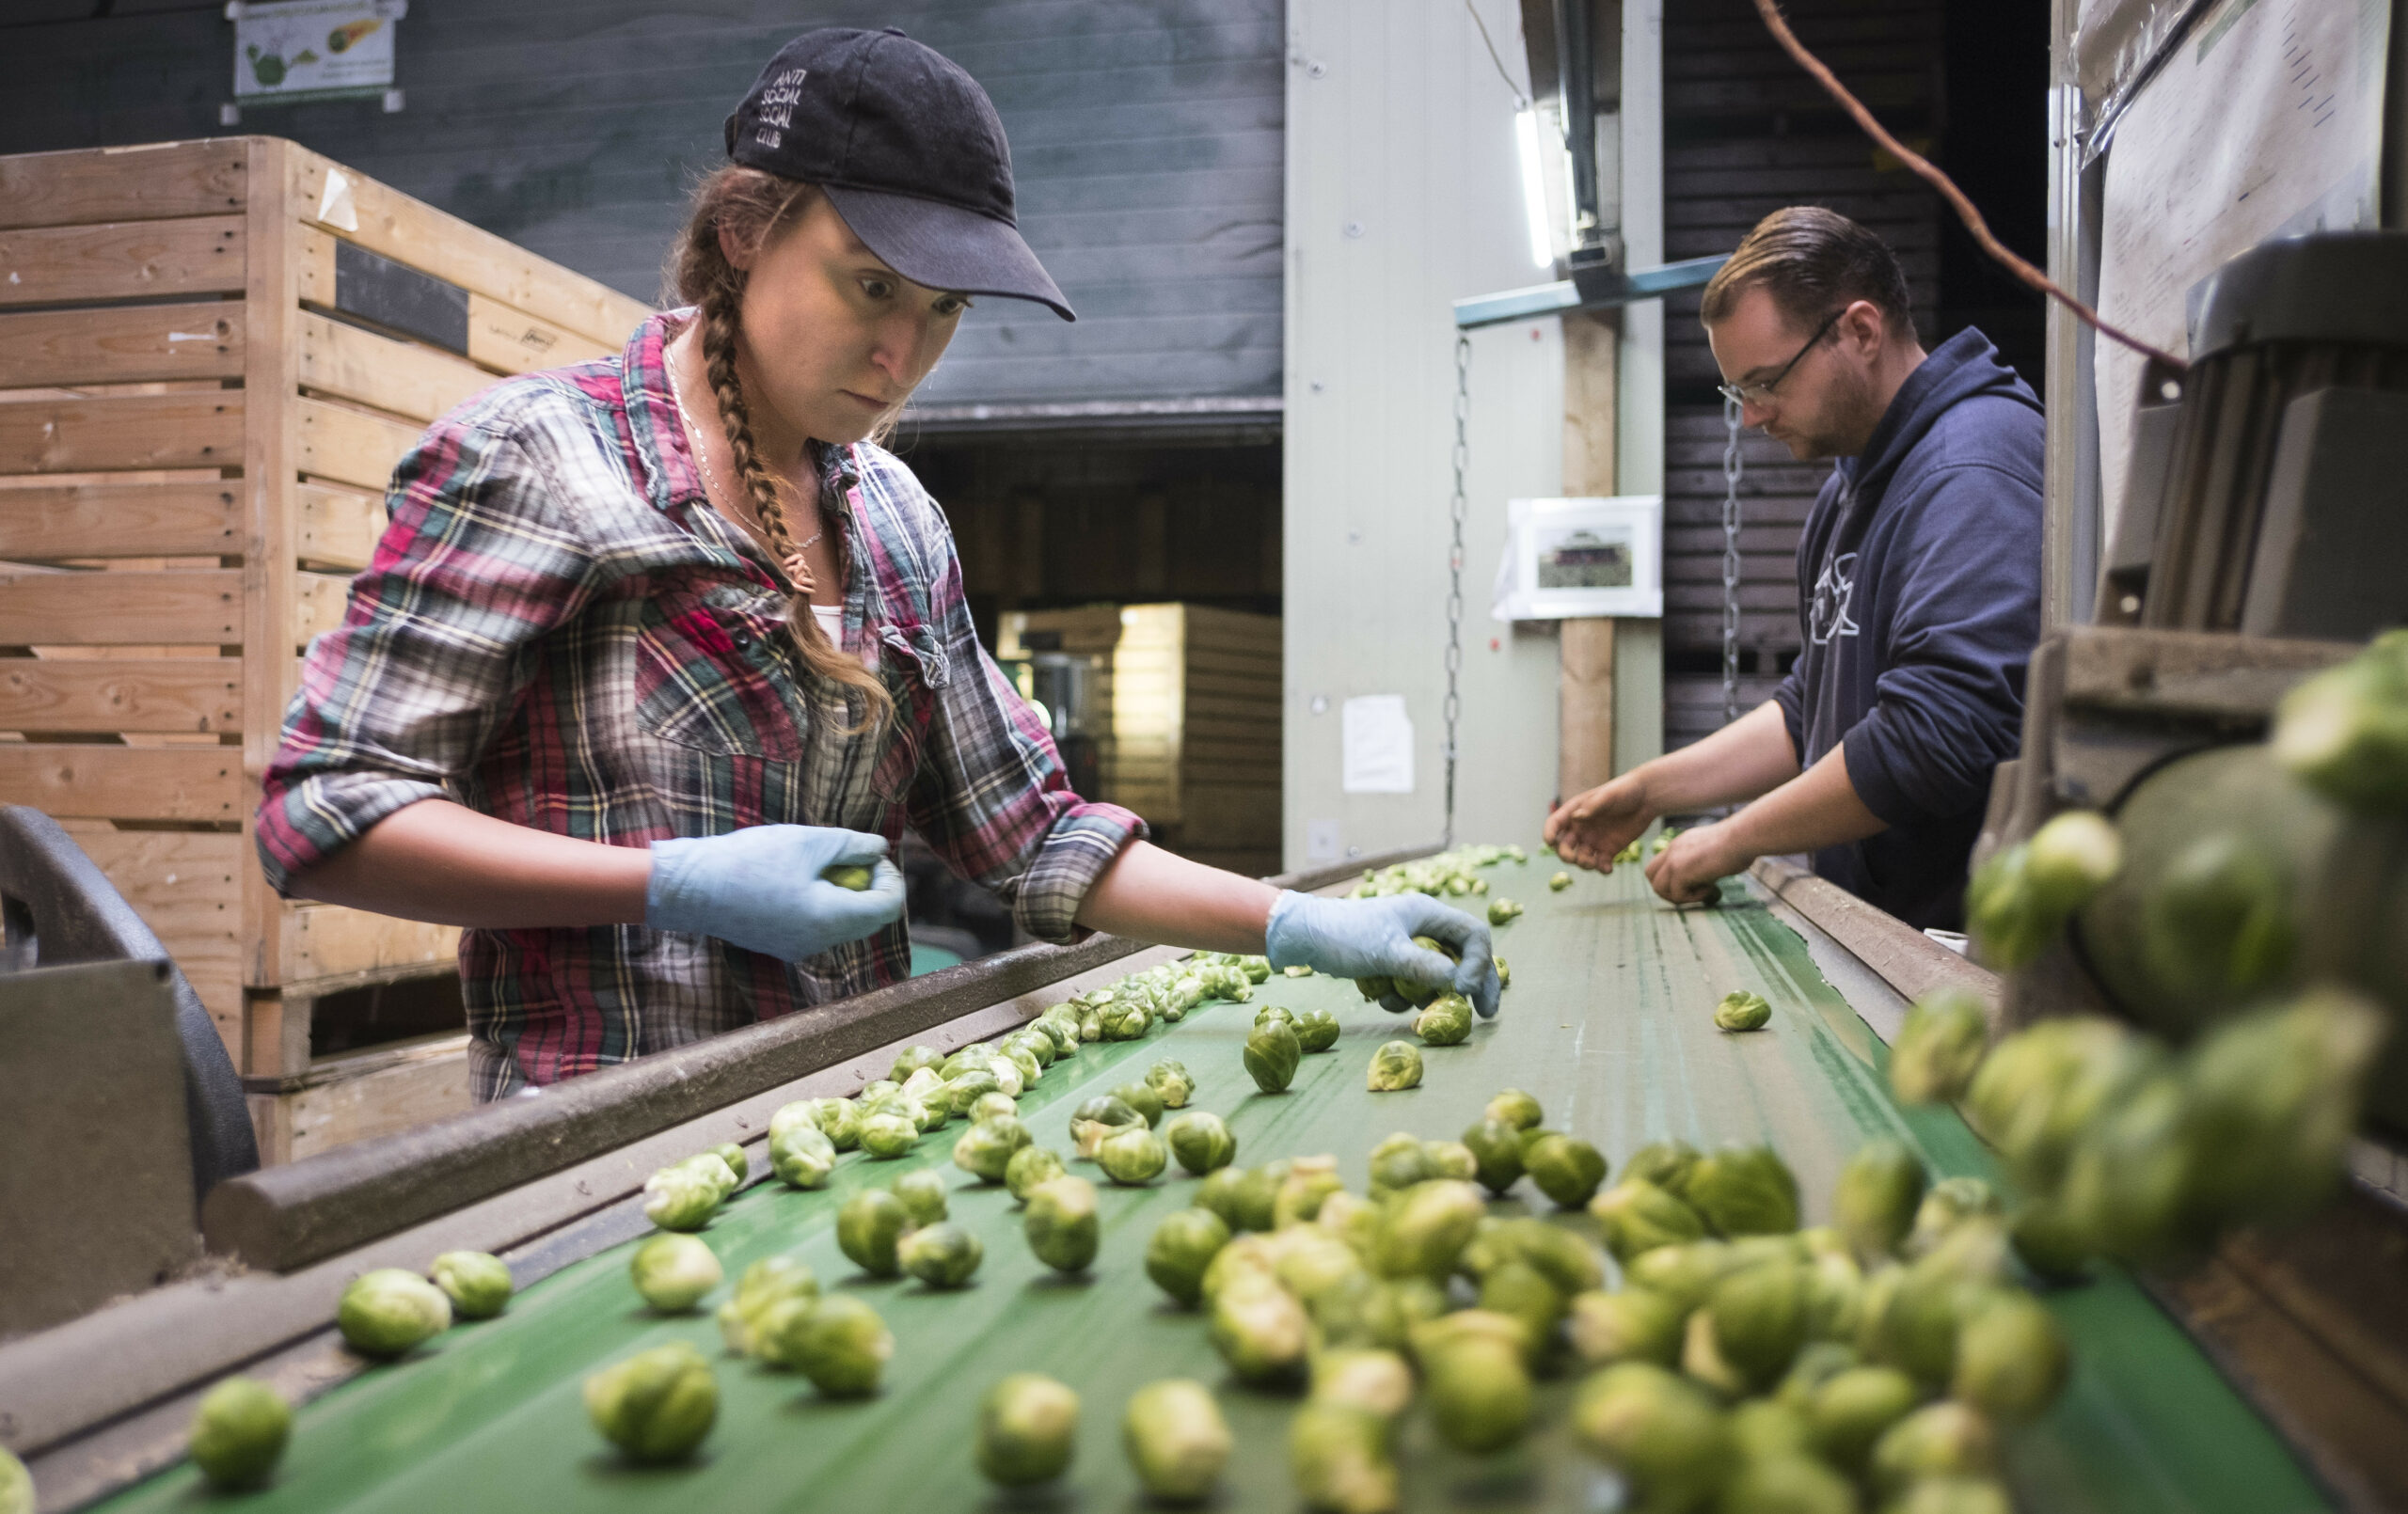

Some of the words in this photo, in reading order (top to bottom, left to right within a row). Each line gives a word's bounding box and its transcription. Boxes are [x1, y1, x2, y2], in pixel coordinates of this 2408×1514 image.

[773, 69, 807, 87] ANTI
[761, 87, 801, 105] SOCIAL
[759, 104, 793, 129] SOCIAL
[756, 128, 781, 149] CLUB
